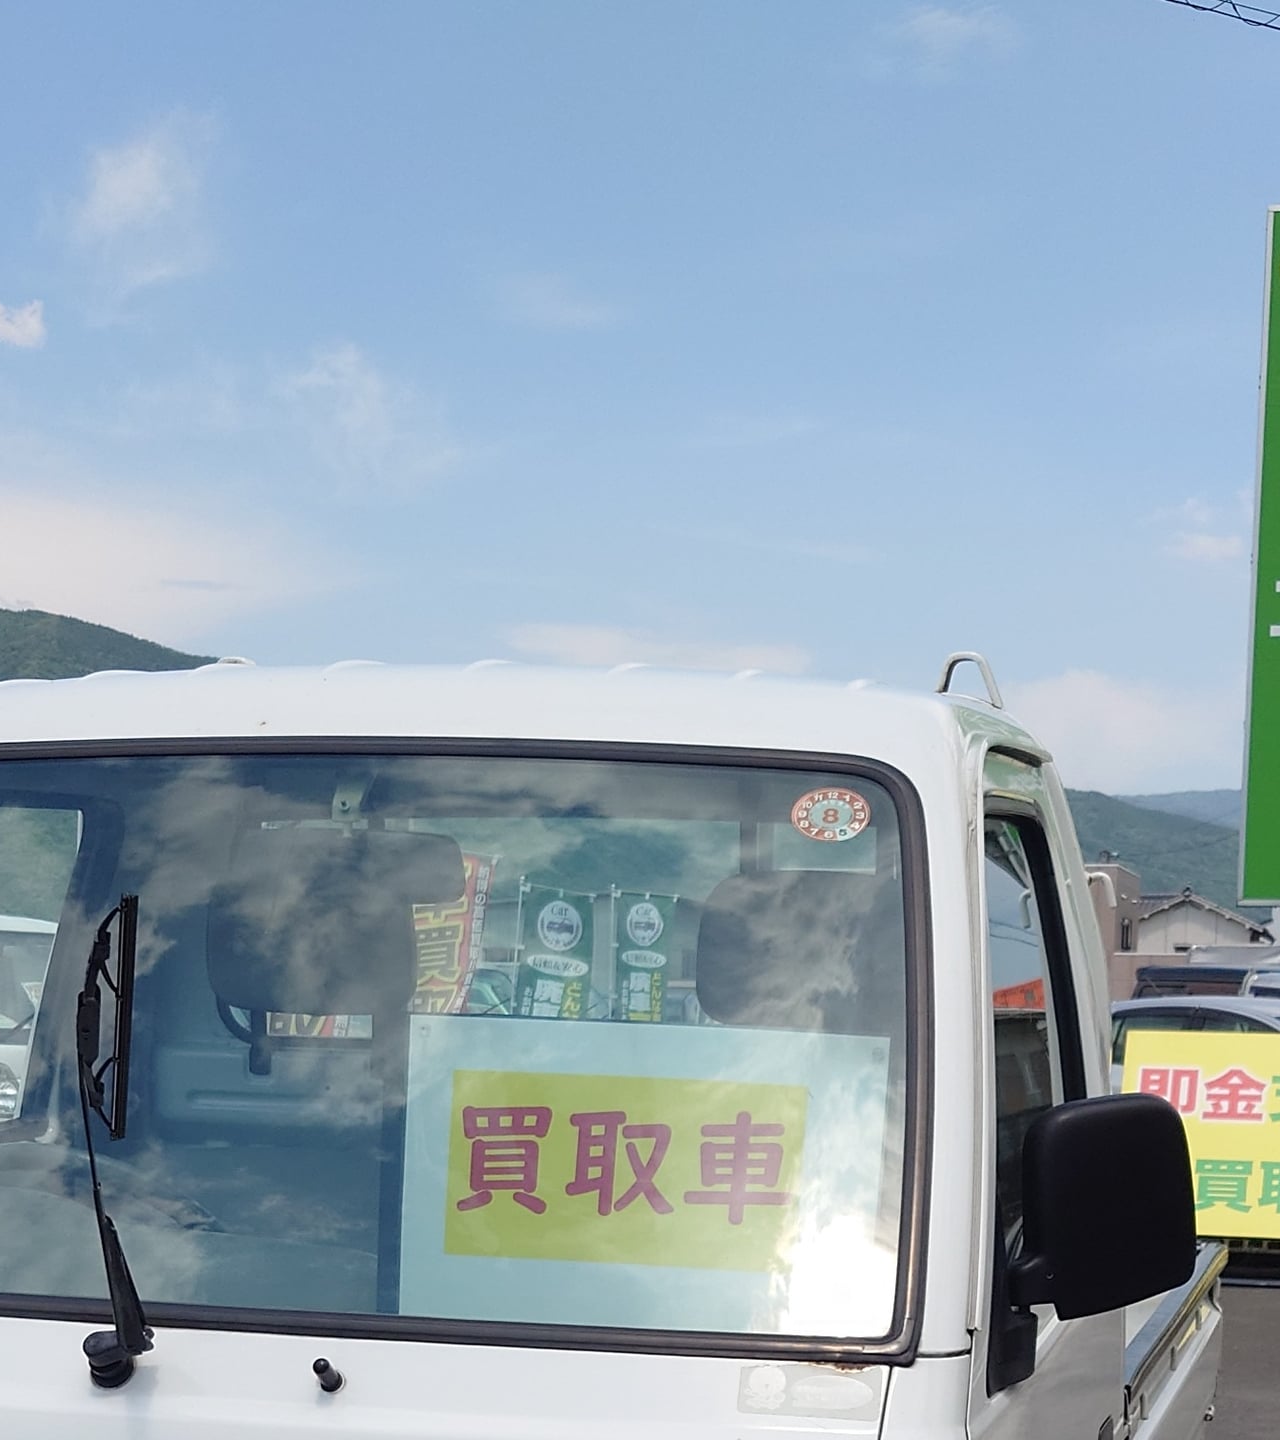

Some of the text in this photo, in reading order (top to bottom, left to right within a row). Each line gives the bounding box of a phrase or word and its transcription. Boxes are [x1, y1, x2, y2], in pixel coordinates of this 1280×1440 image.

[823, 808, 839, 823] 8
[456, 1105, 797, 1226] 買取車
